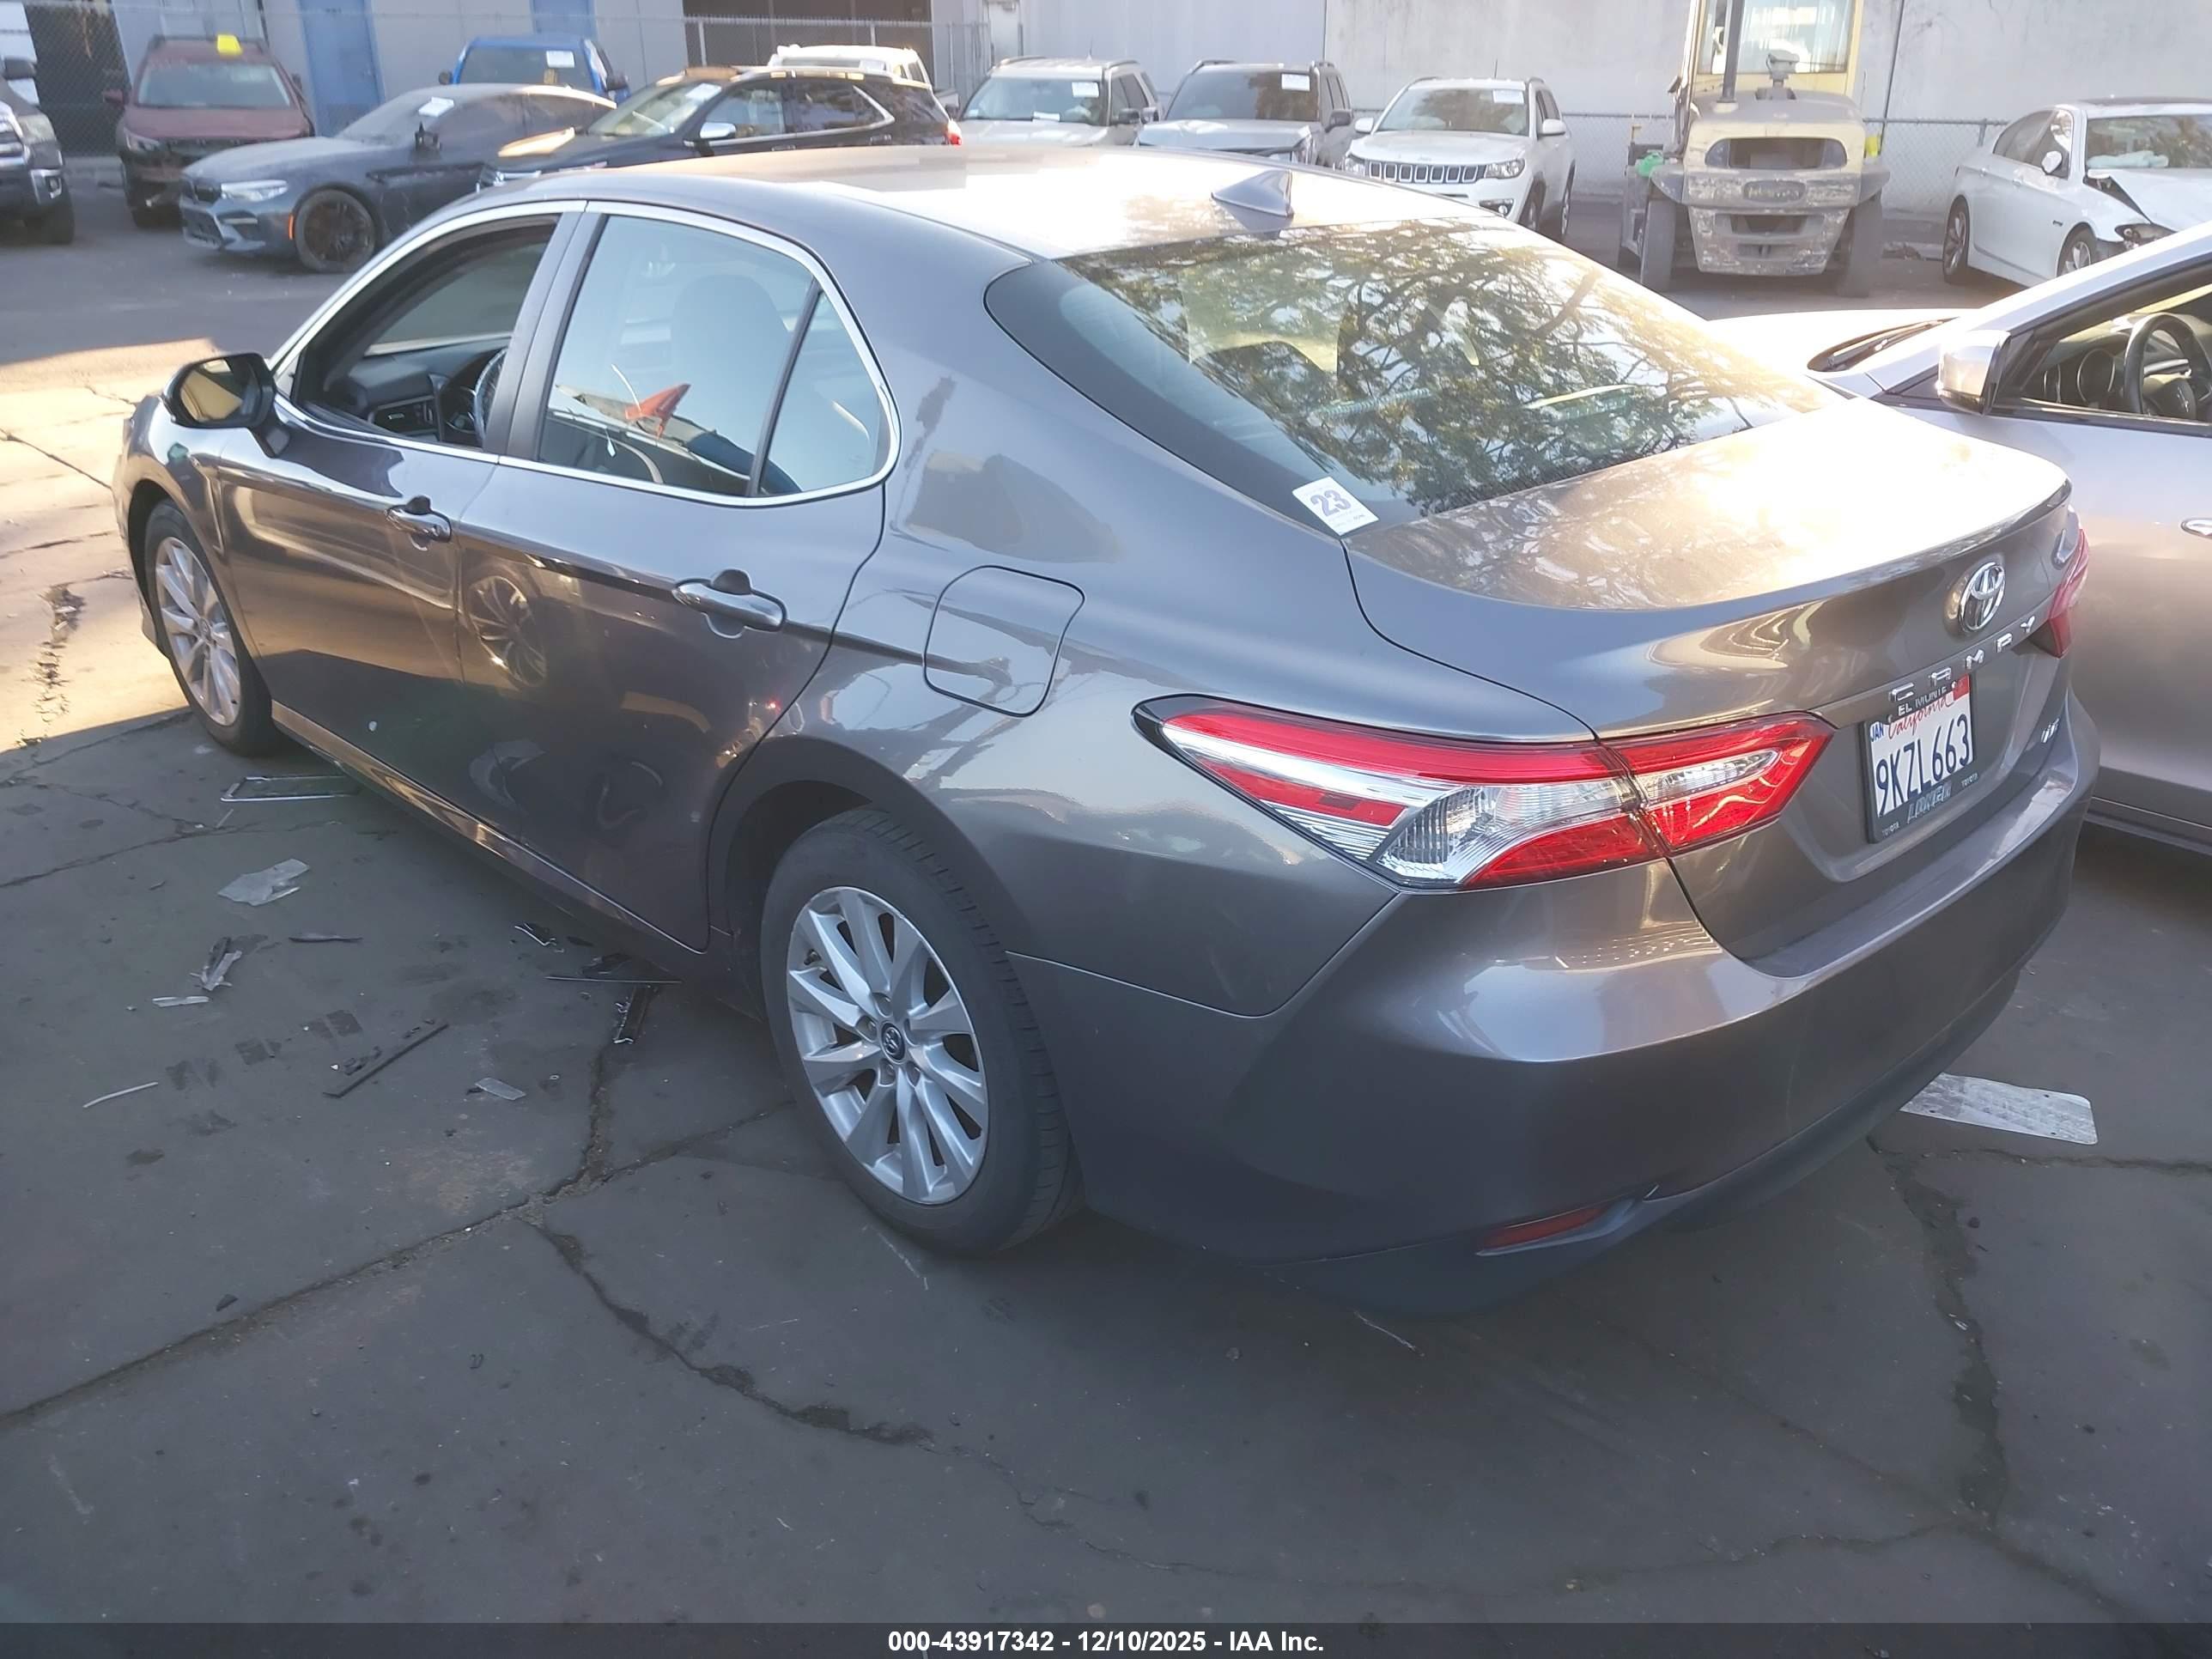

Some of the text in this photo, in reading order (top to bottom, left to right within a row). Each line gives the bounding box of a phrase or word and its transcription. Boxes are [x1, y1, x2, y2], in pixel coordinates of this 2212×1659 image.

[1310, 489, 1352, 517] 23
[1898, 703, 1913, 716] EL
[1871, 723, 1885, 742] JAN
[1875, 714, 1970, 818] 9KZL663
